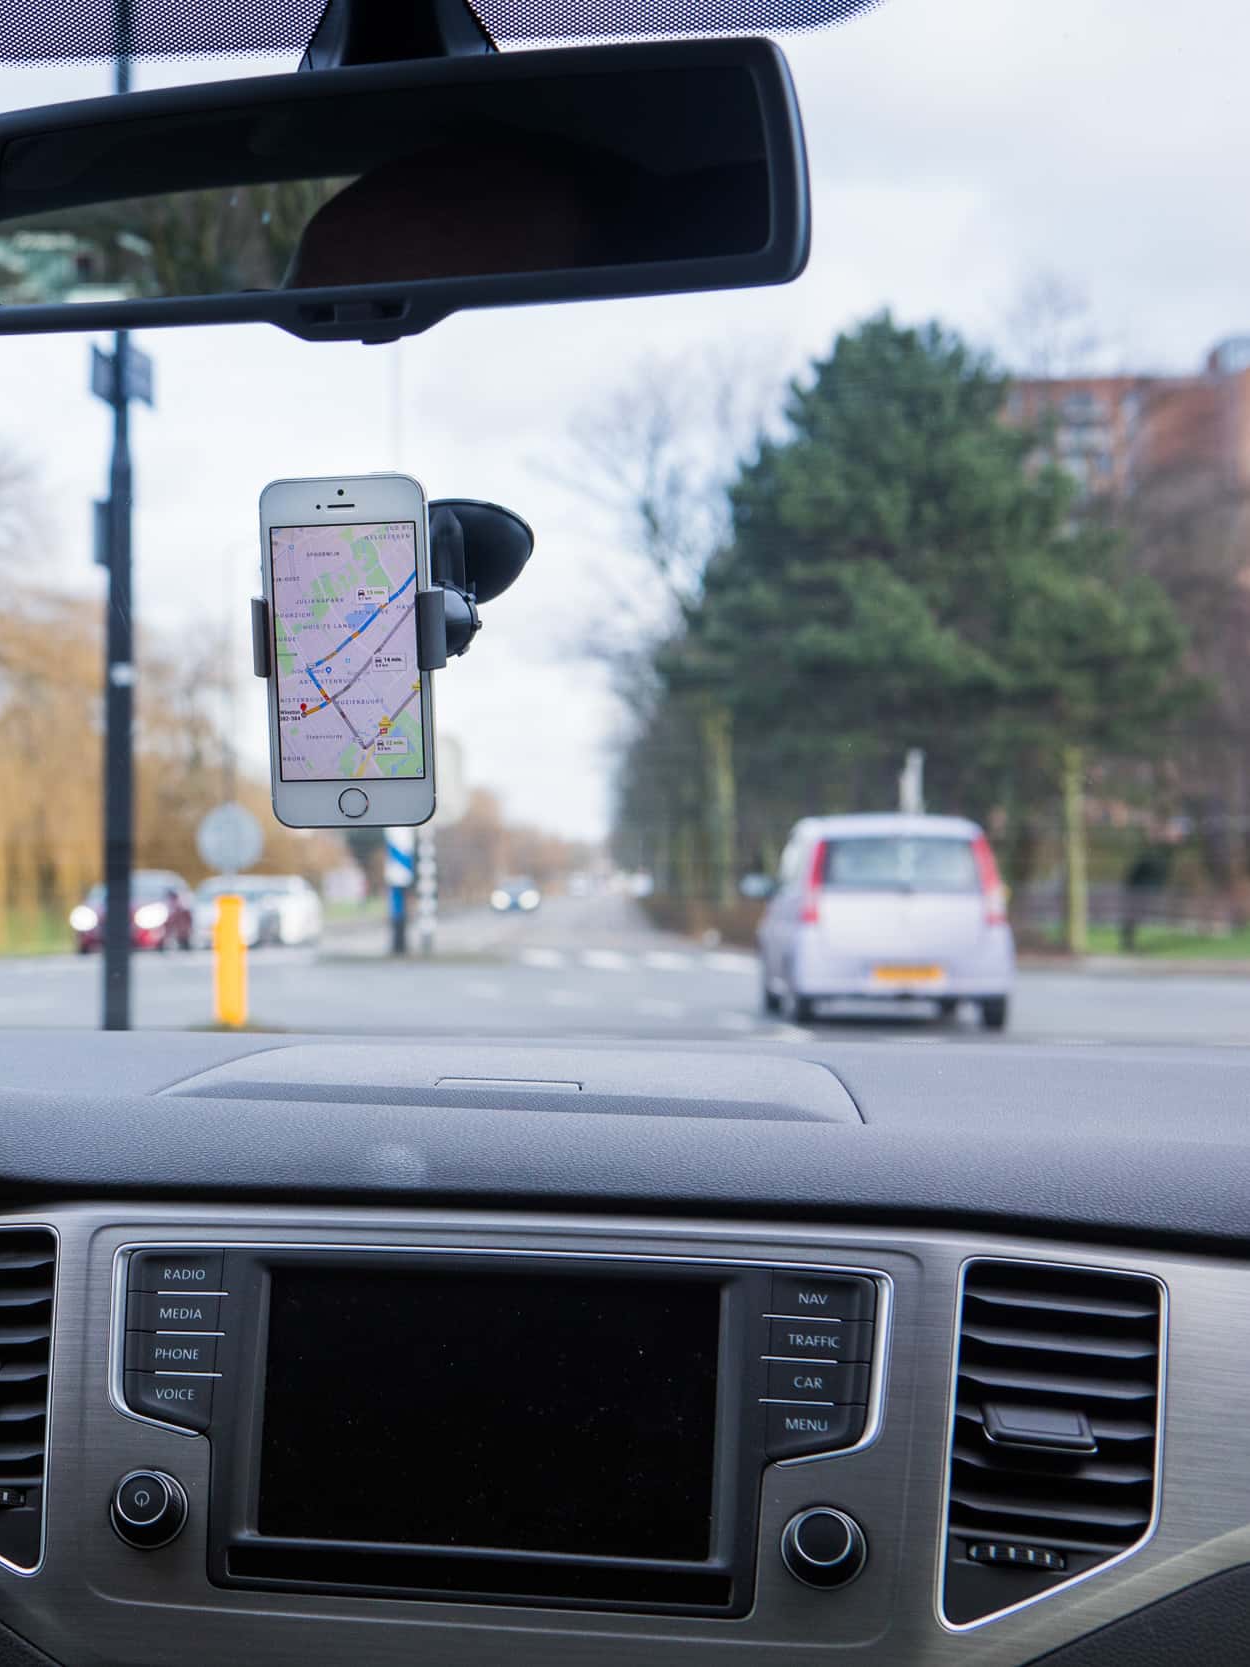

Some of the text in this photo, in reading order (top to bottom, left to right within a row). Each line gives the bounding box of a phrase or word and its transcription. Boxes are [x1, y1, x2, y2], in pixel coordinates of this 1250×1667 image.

[164, 1269, 206, 1280] RADIO
[799, 1293, 828, 1305] NAV
[159, 1308, 202, 1320] MEDIA
[788, 1333, 840, 1348] TRAFFIC
[154, 1348, 199, 1360] PHONE
[794, 1376, 823, 1389] CAR
[155, 1388, 195, 1401] VOICE
[785, 1417, 828, 1431] MENU
